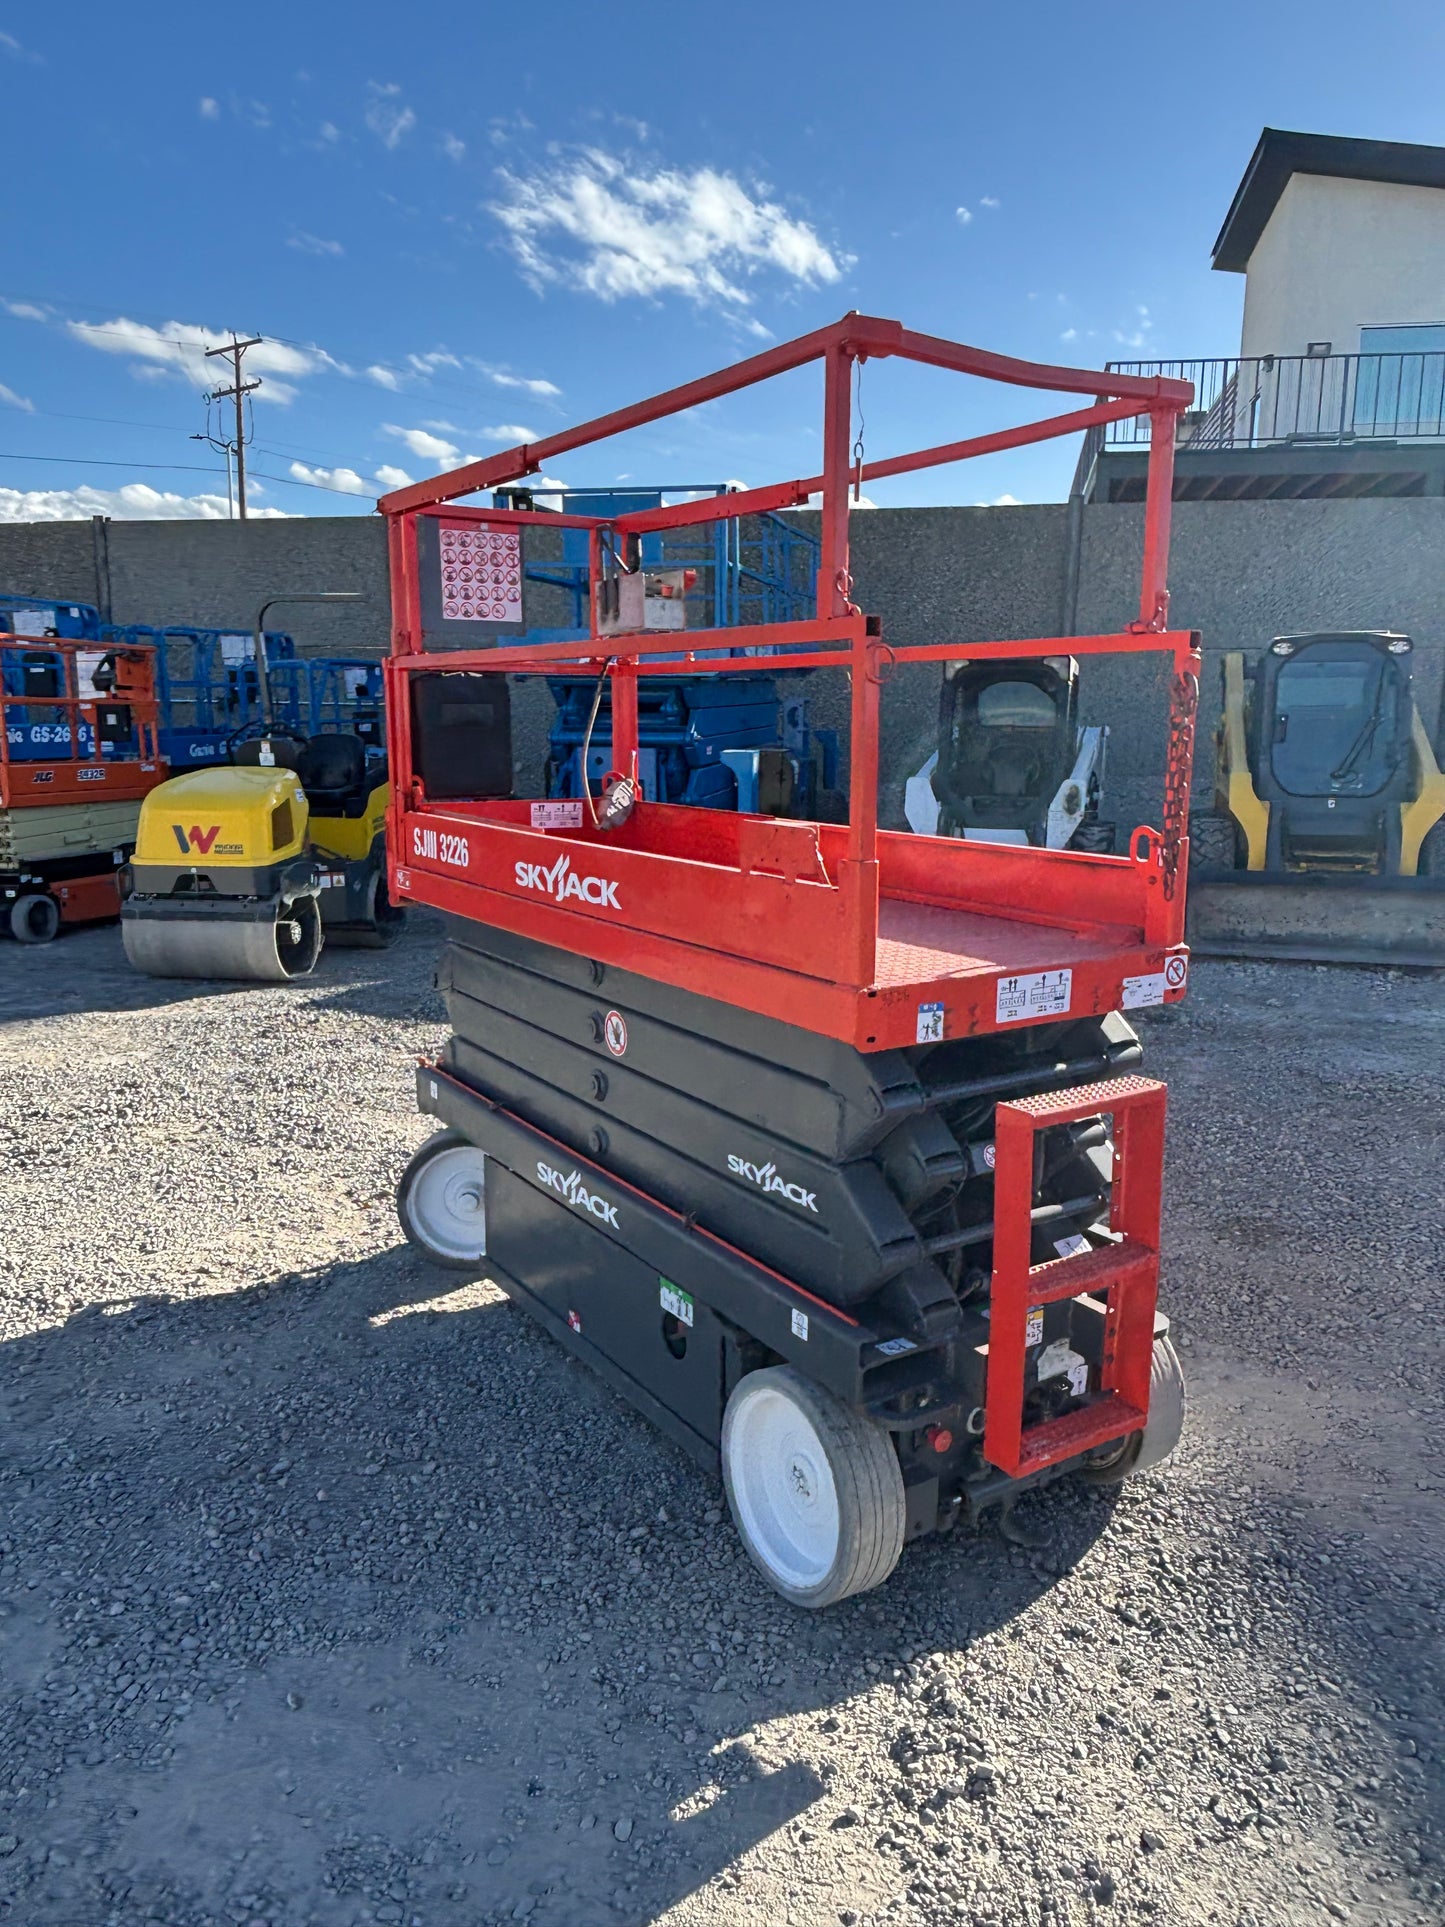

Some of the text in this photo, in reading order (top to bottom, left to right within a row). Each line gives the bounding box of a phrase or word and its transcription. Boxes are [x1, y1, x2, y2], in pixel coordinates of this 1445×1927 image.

[30, 726, 87, 743] GS-266
[32, 771, 54, 783] JLG
[413, 827, 469, 867] SJIII 3226
[514, 853, 623, 910] SKYJACK
[536, 1161, 620, 1230] SKYJACK
[727, 1153, 819, 1213] SKYJACK
